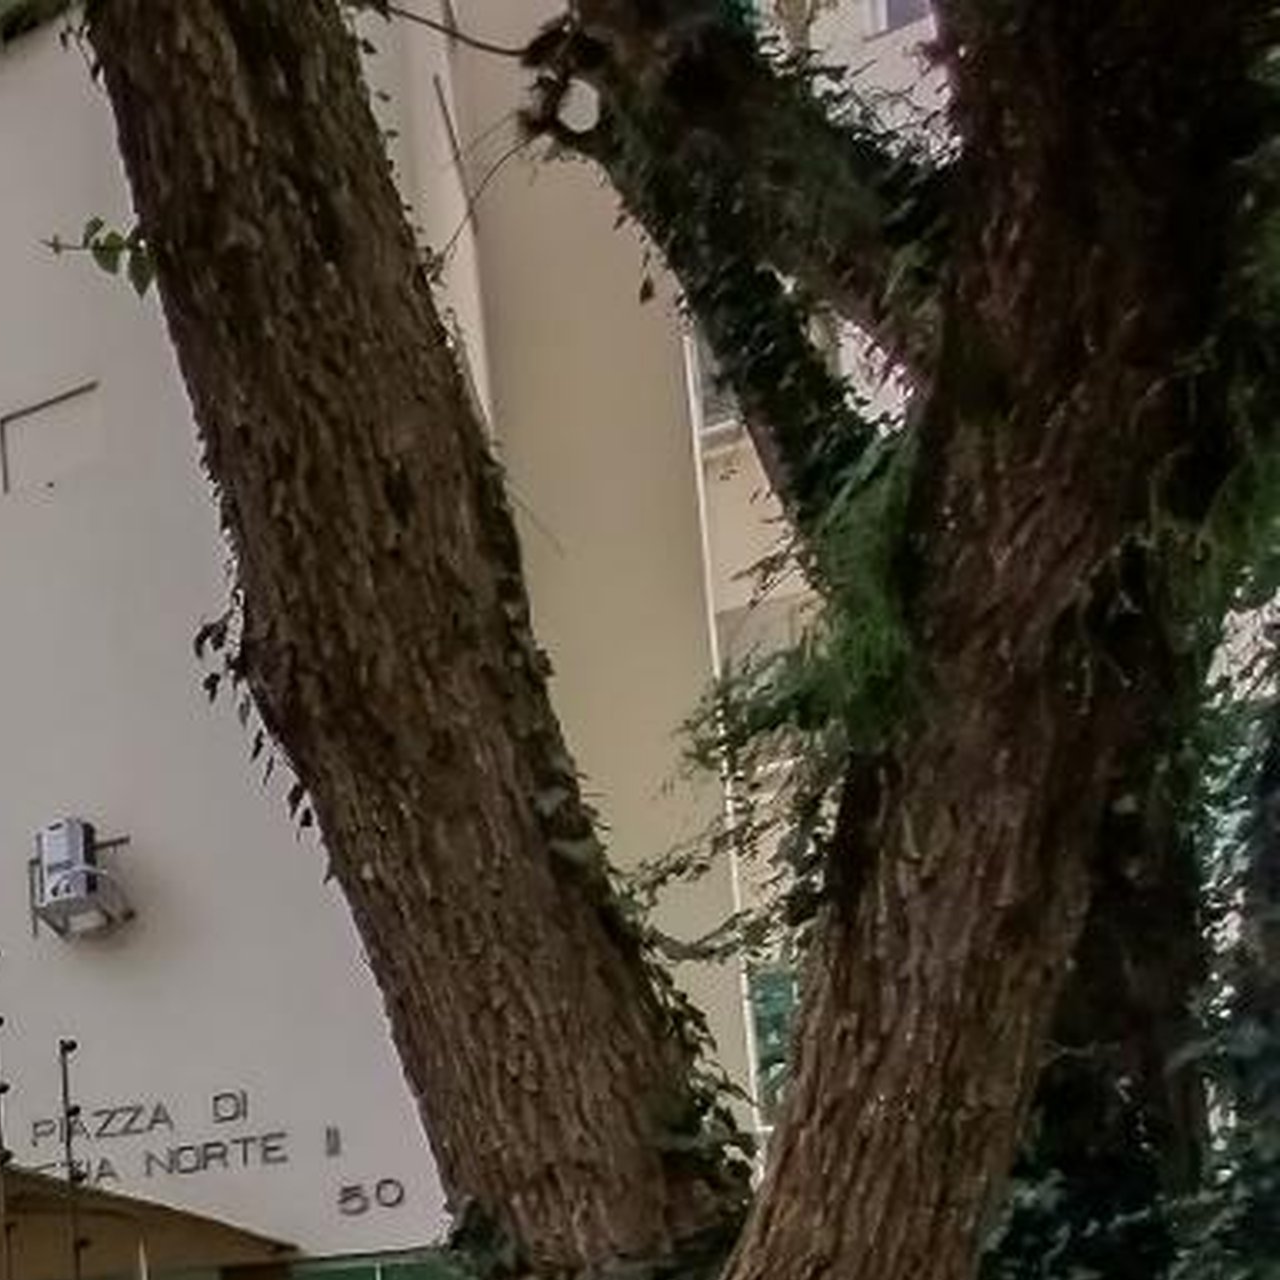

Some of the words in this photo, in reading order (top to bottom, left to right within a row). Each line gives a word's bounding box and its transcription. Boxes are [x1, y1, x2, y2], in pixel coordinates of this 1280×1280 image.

[213, 1090, 248, 1123] DI
[144, 1131, 288, 1176] NORTE
[338, 1178, 404, 1215] 50
